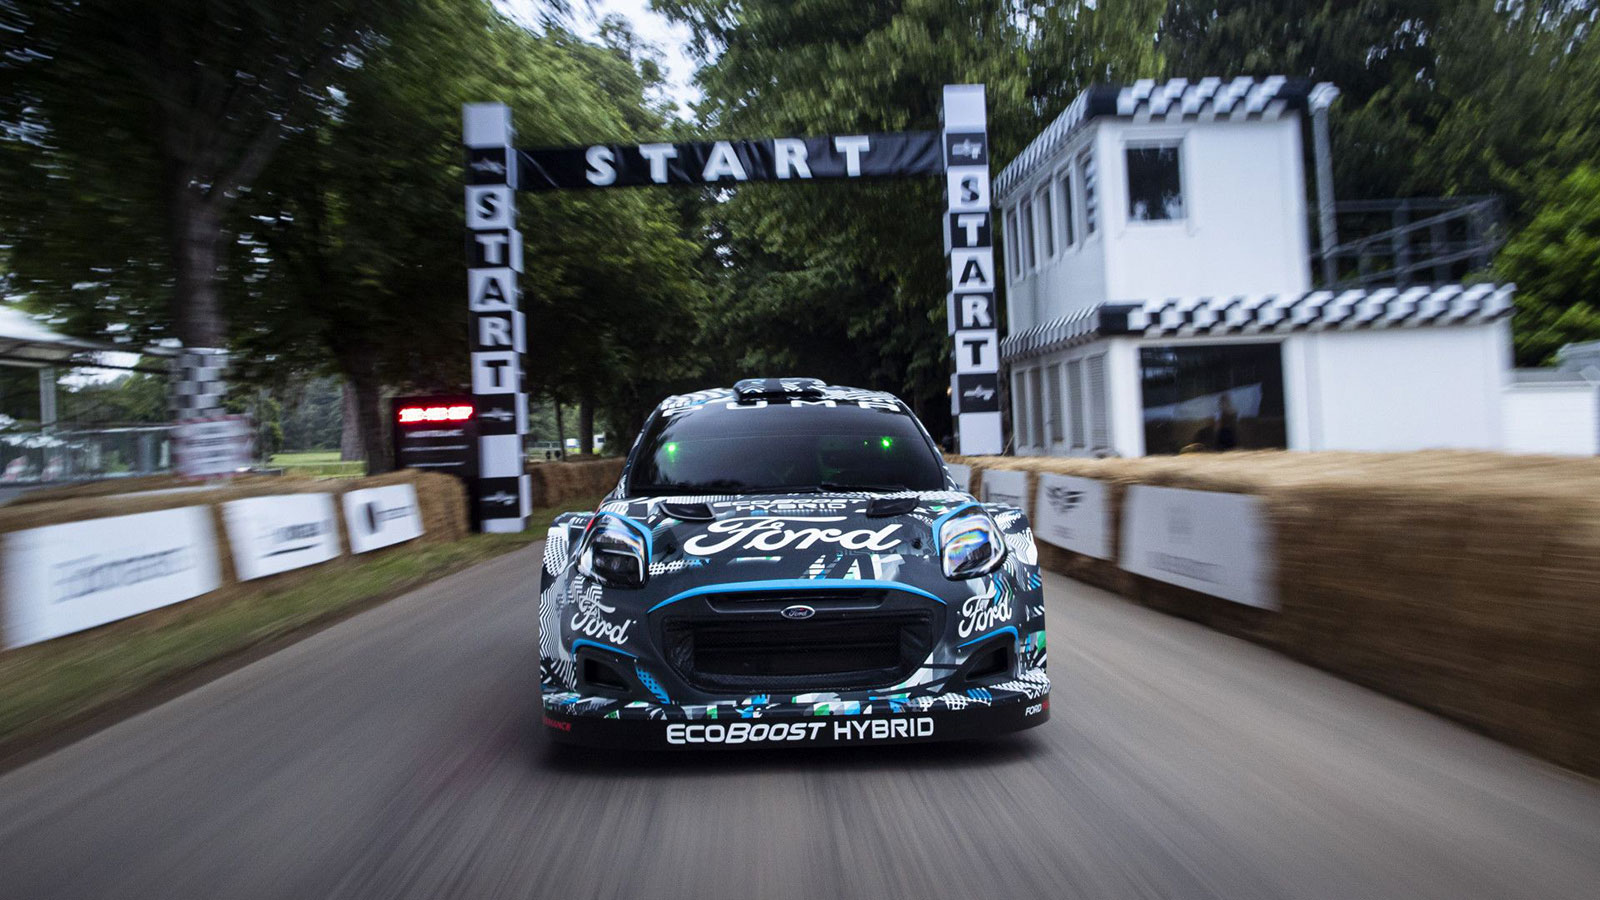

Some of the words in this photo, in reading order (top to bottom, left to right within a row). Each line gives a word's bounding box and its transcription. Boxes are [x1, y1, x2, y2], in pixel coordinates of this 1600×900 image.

[585, 135, 870, 186] START
[475, 192, 511, 388] START
[957, 175, 992, 366] START
[736, 503, 847, 512] HYBRID
[683, 516, 903, 555] Ford
[571, 597, 632, 645] Ford
[958, 580, 1012, 637] Ford
[666, 722, 826, 744] ECOBOOST
[834, 717, 934, 740] HYBRID
[1025, 703, 1042, 716] FORD
